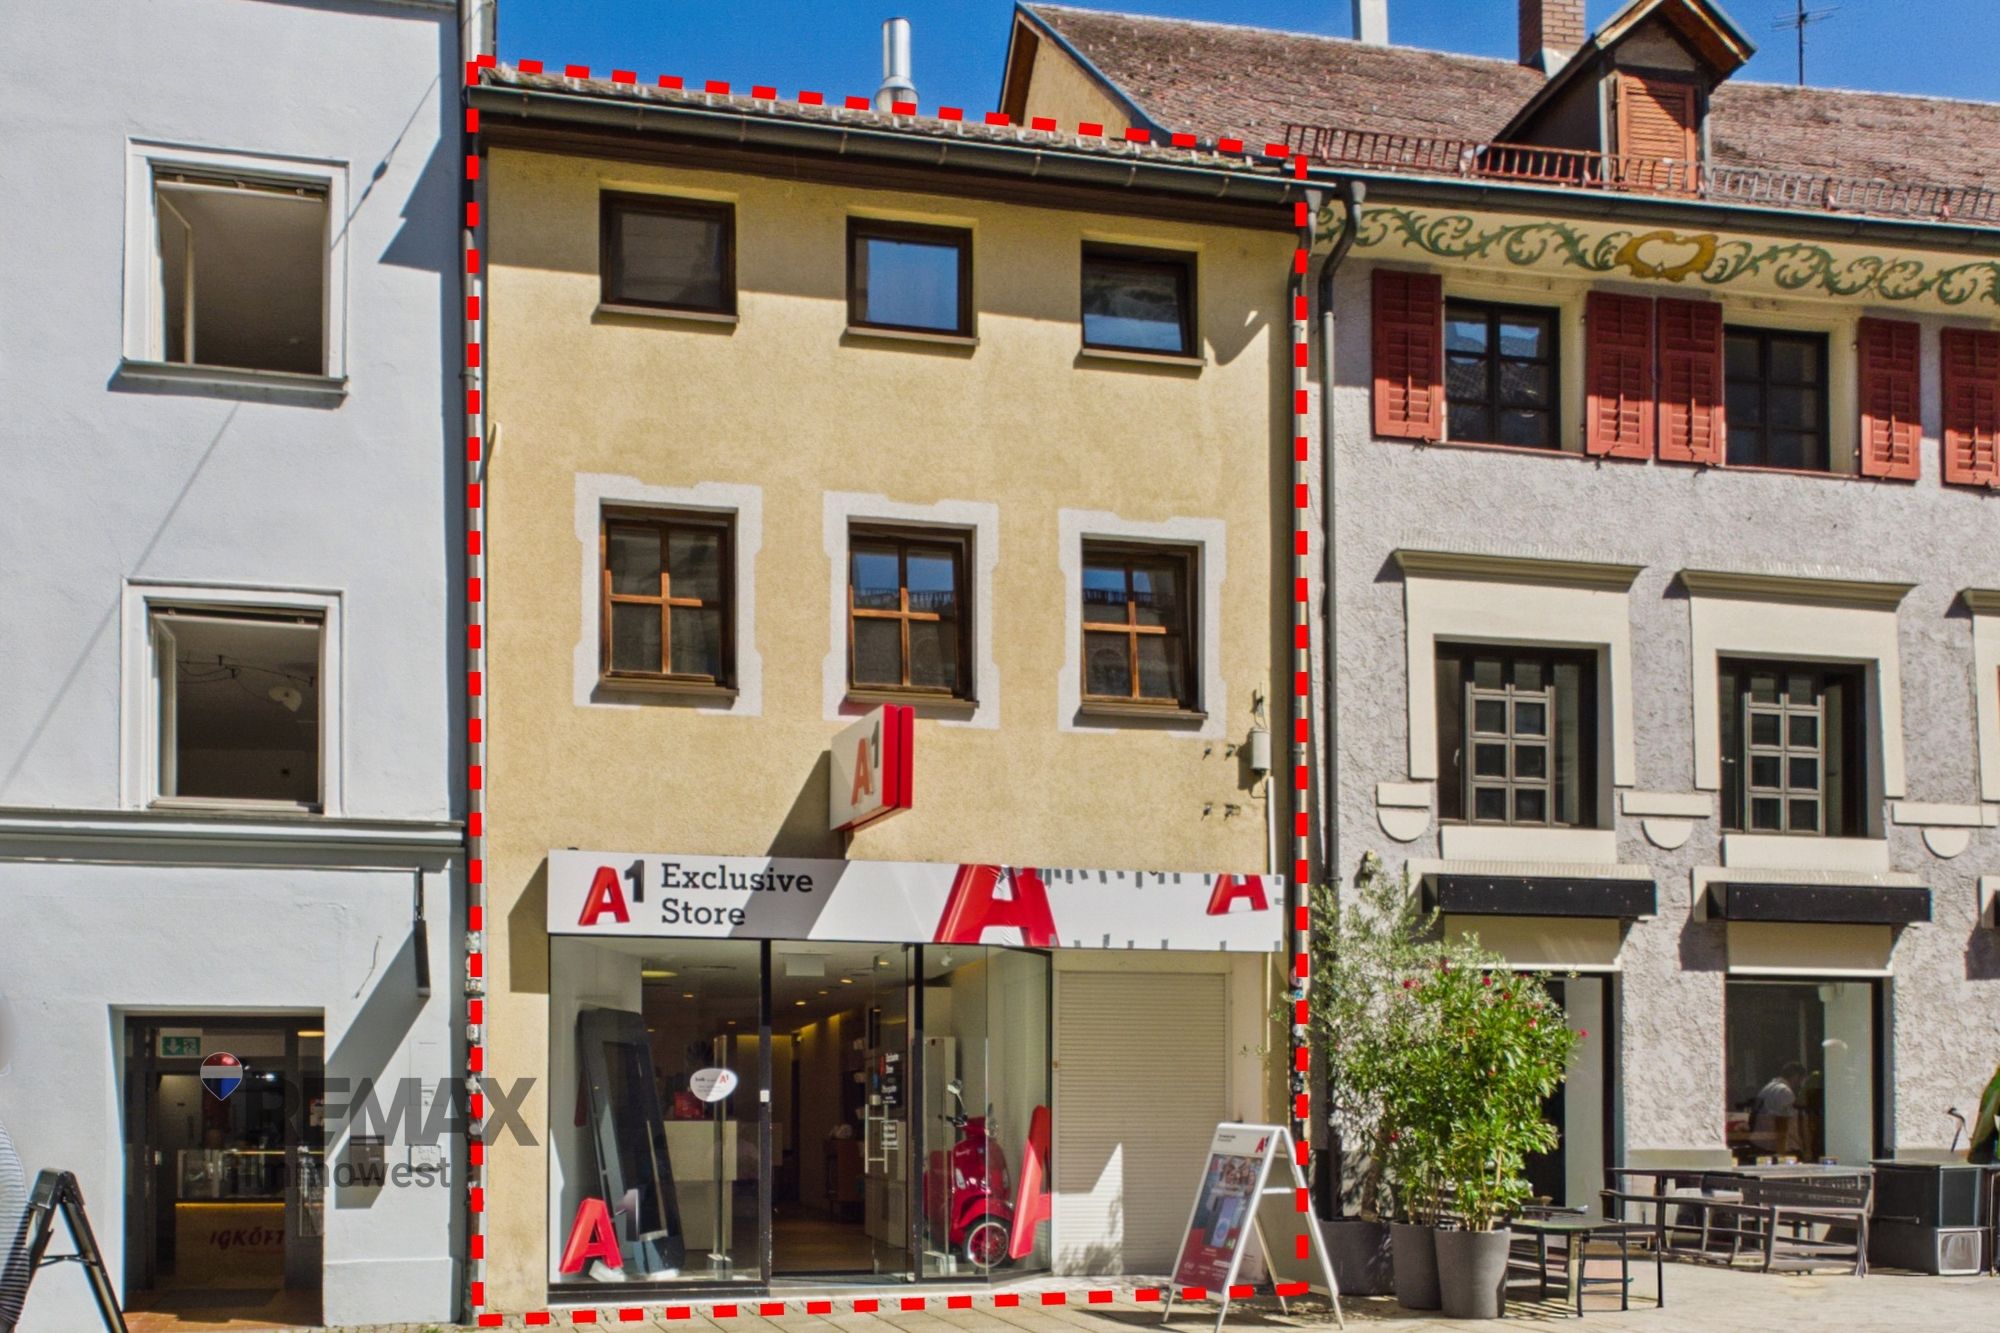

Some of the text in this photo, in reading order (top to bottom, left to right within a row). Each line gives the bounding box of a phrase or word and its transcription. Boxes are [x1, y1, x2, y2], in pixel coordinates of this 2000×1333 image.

[851, 720, 880, 806] A1
[577, 859, 645, 926] A1
[661, 862, 814, 893] Exclusive
[661, 898, 746, 926] Store
[559, 1187, 639, 1274] A1
